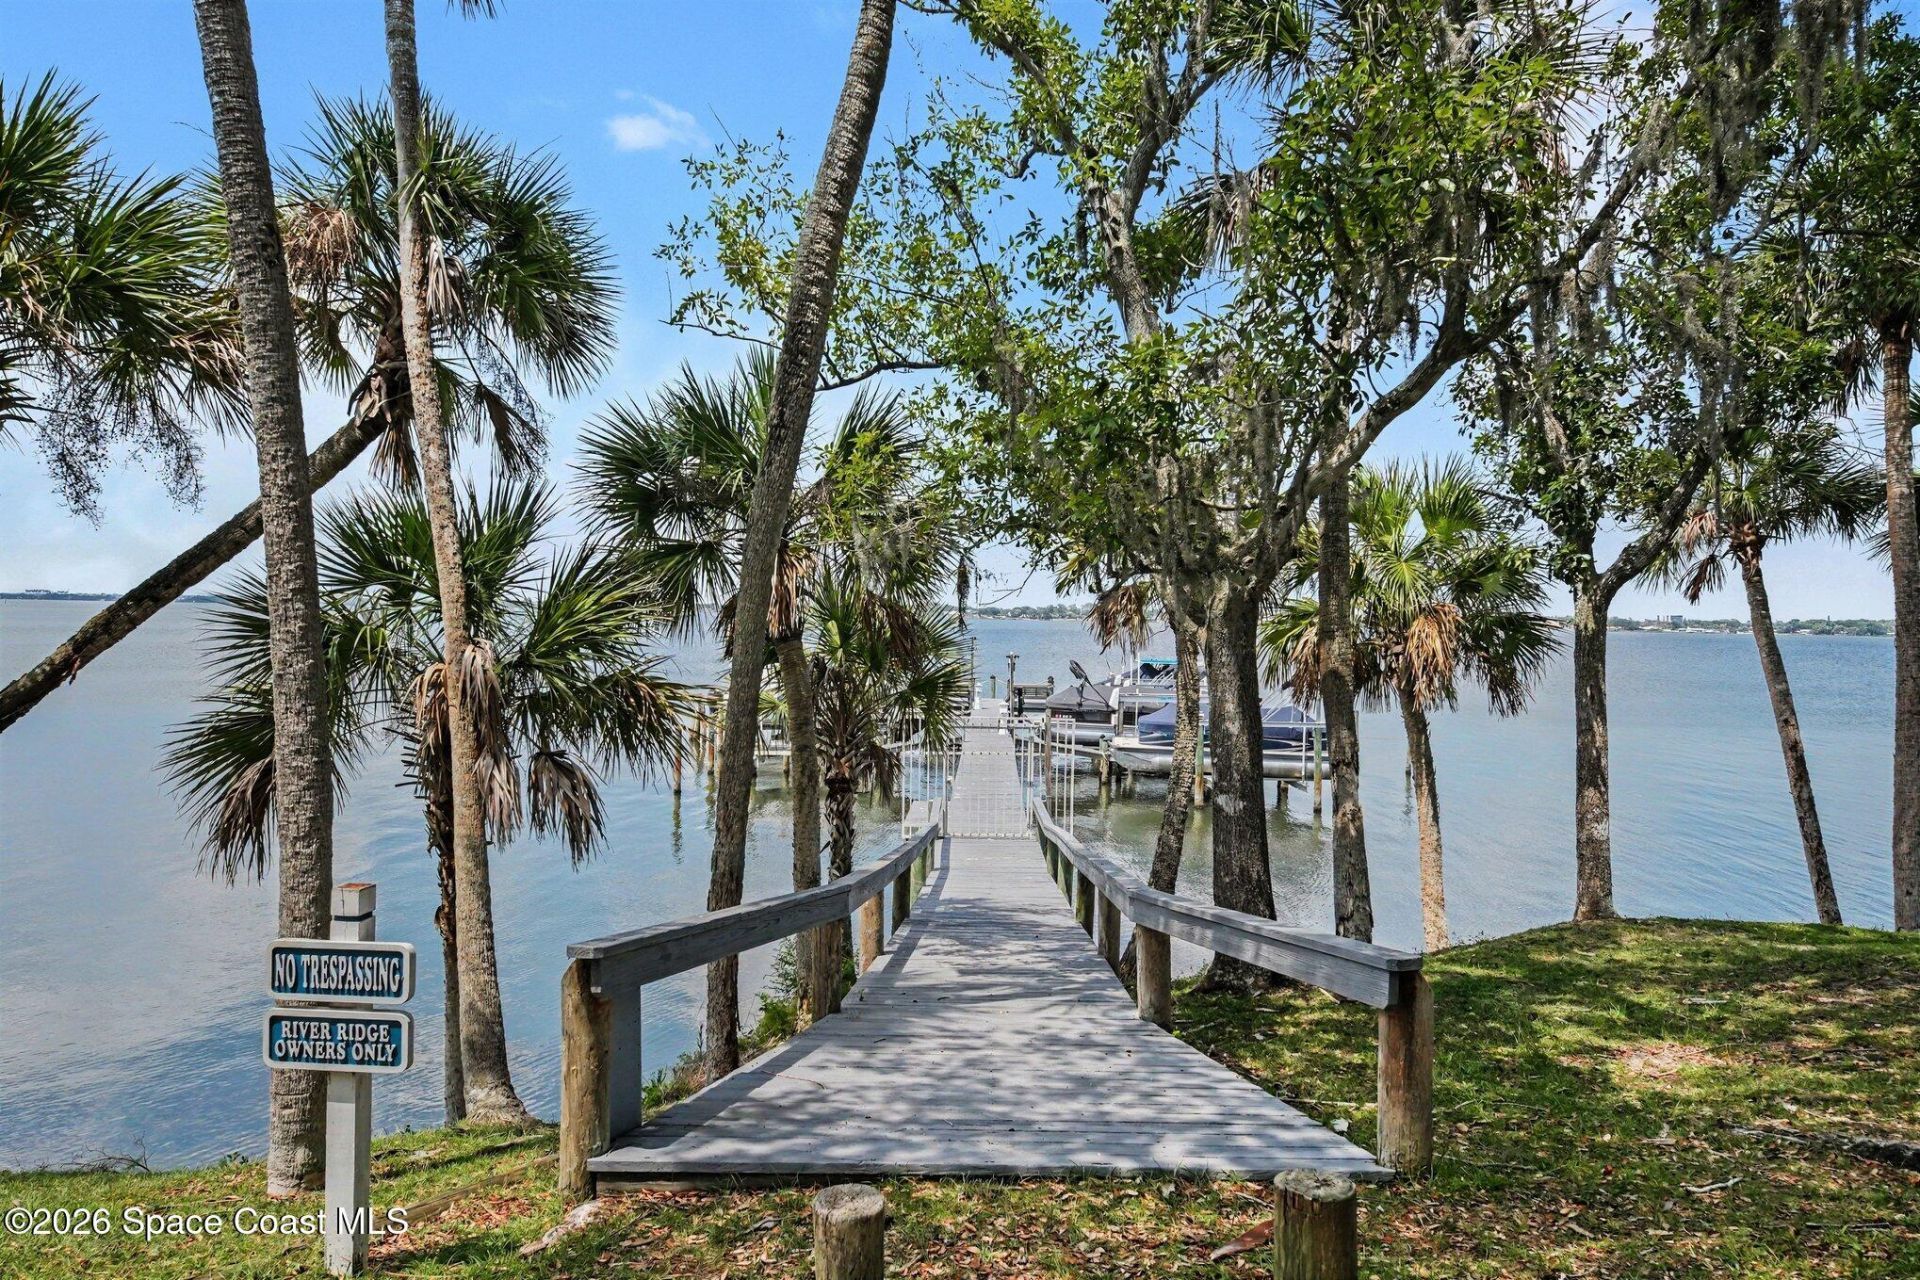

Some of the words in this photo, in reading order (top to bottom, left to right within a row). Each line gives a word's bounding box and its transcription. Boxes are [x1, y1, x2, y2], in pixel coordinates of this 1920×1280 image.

[274, 953, 296, 988] NO
[301, 954, 400, 992] TRESPASSING
[281, 1020, 331, 1040] RIVER
[337, 1023, 389, 1042] RIDGE
[274, 1040, 346, 1060] OWNERS
[352, 1042, 396, 1062] ONLY
